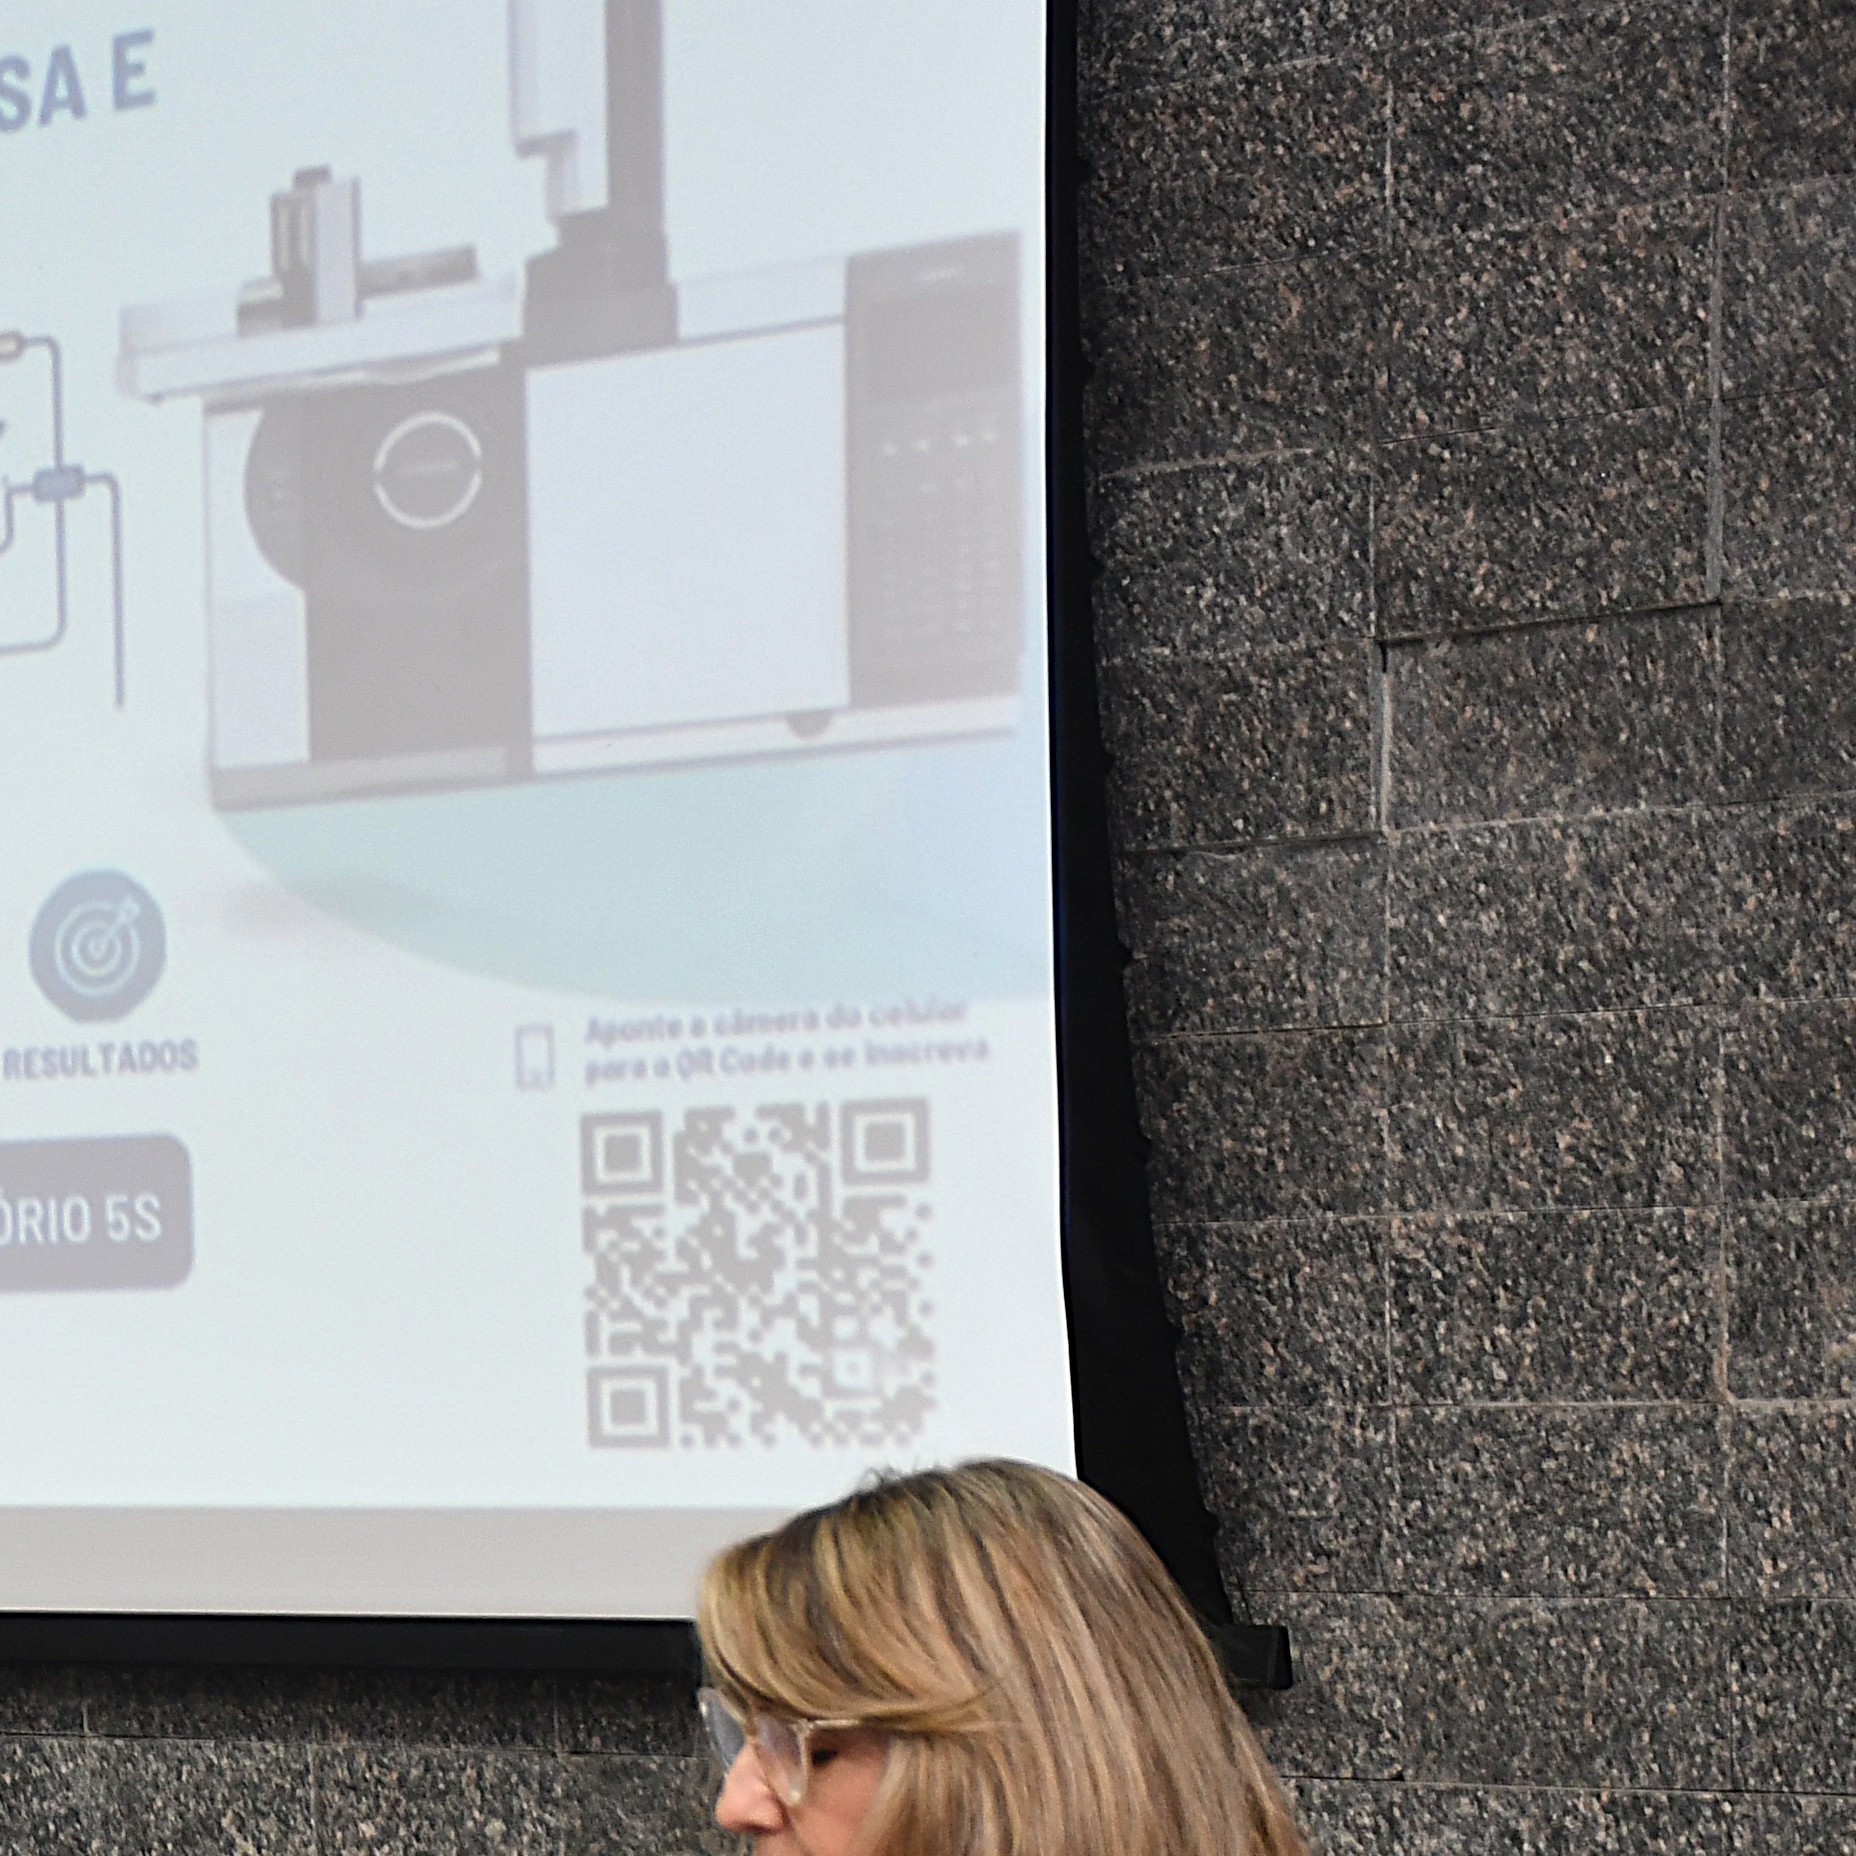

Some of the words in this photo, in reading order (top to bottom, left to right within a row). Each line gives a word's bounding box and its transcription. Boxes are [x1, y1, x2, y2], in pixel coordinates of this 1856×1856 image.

[112, 28, 157, 112] E
[2, 1037, 200, 1082] RESULTADOS
[105, 1192, 163, 1243] 5S
